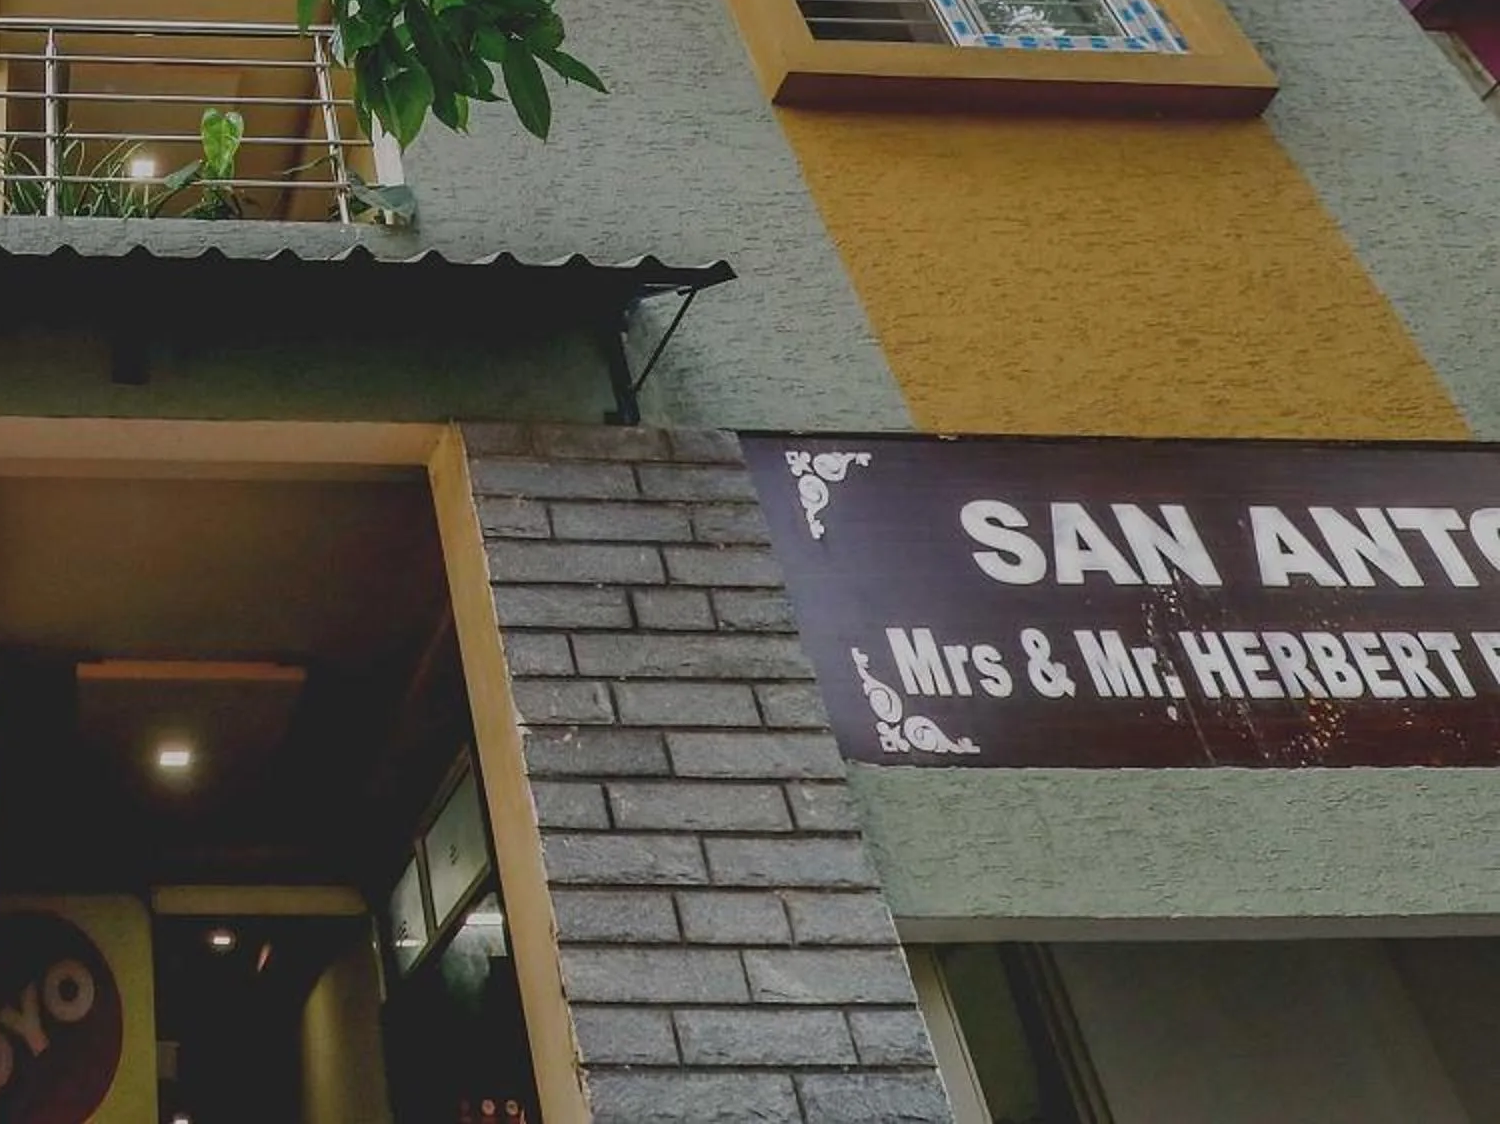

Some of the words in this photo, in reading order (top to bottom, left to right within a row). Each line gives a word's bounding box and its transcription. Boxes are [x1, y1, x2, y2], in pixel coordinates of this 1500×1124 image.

[959, 499, 1223, 587] SAN
[884, 626, 1013, 698] Mrs
[1019, 627, 1077, 699] &
[1073, 629, 1186, 699] Mr.
[1181, 631, 1477, 700] HERBERT
